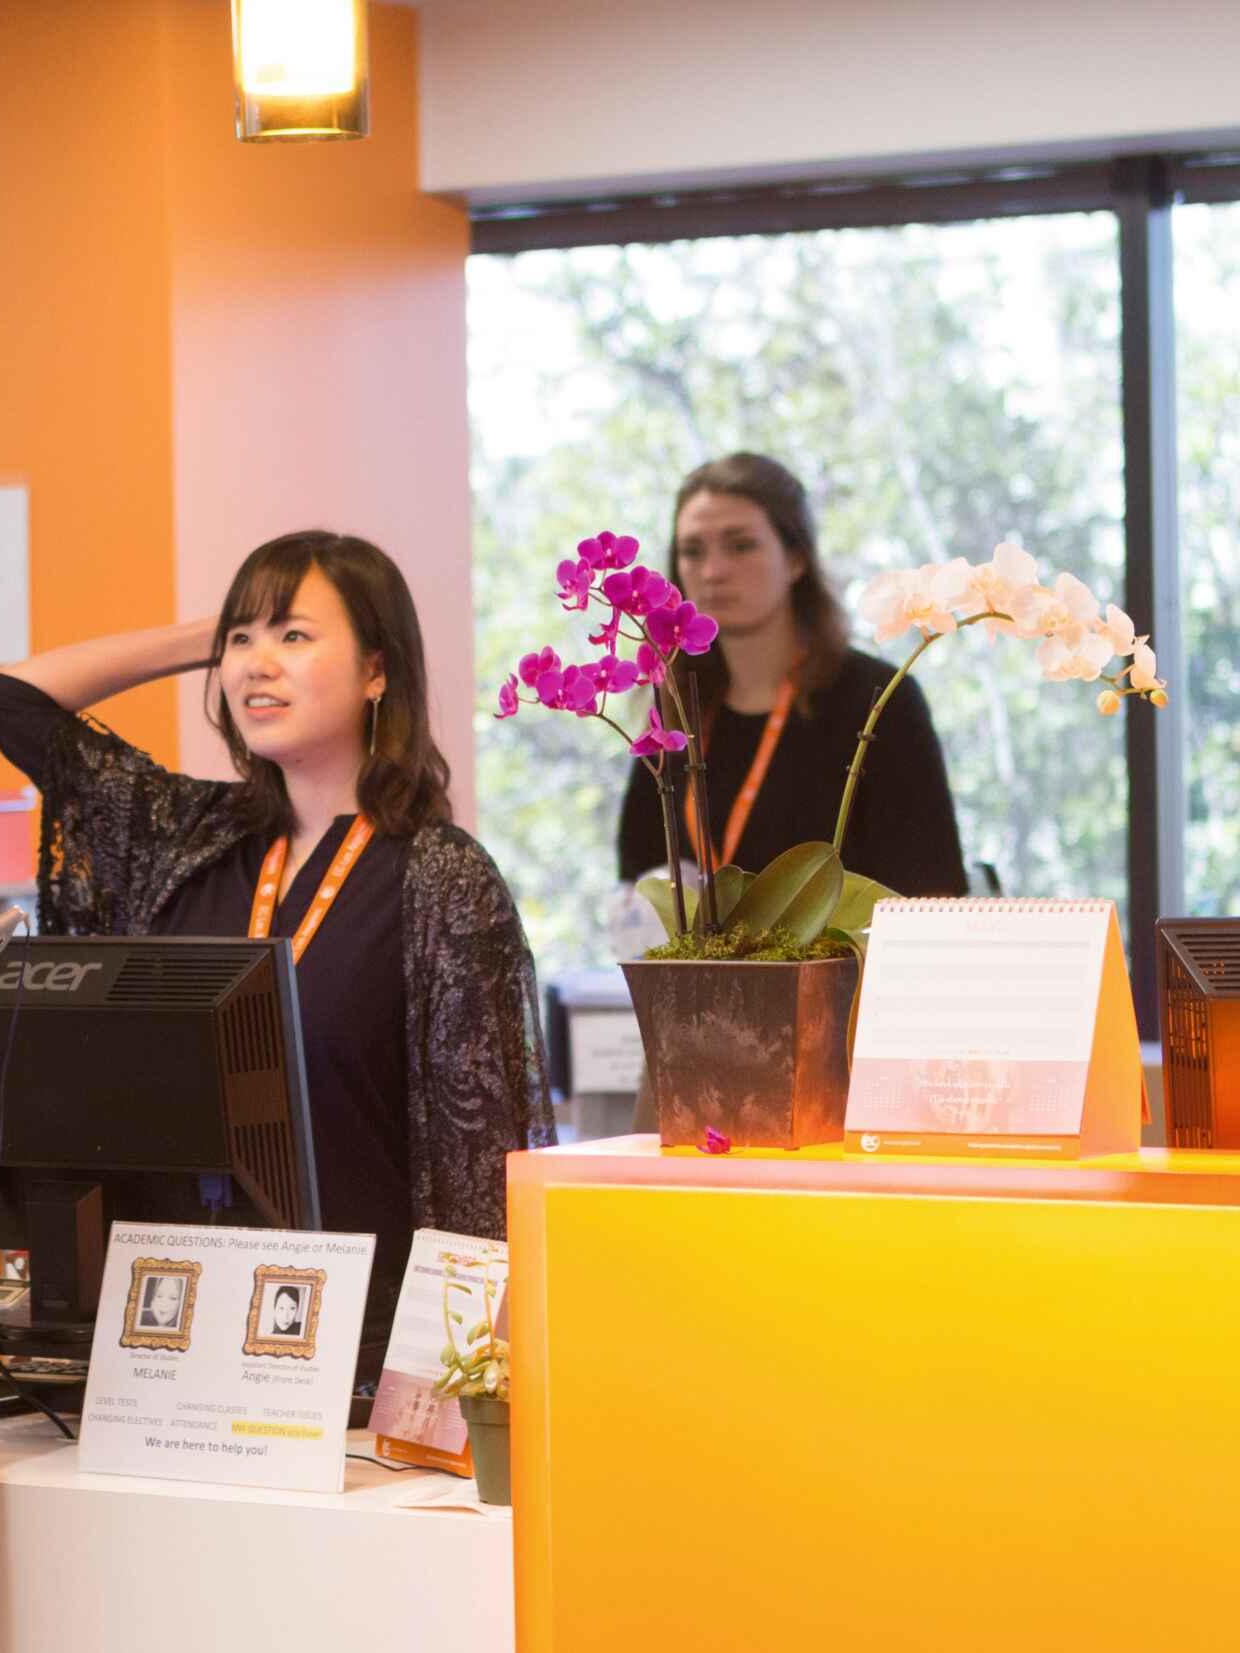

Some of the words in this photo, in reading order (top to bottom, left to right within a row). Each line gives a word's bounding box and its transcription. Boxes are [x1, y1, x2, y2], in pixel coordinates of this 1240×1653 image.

[114, 1232, 167, 1247] ACADEMIC
[167, 1234, 225, 1249] QUESTIONS:
[228, 1236, 259, 1250] Please
[261, 1241, 280, 1250] see
[280, 1240, 309, 1255] Angie
[133, 1367, 177, 1381] MELANIE
[241, 1369, 271, 1385] Angie
[144, 1436, 162, 1448] We
[163, 1440, 181, 1449] are
[182, 1438, 206, 1452] here
[208, 1441, 220, 1452] to
[222, 1442, 243, 1456] help
[245, 1445, 268, 1457] you!
